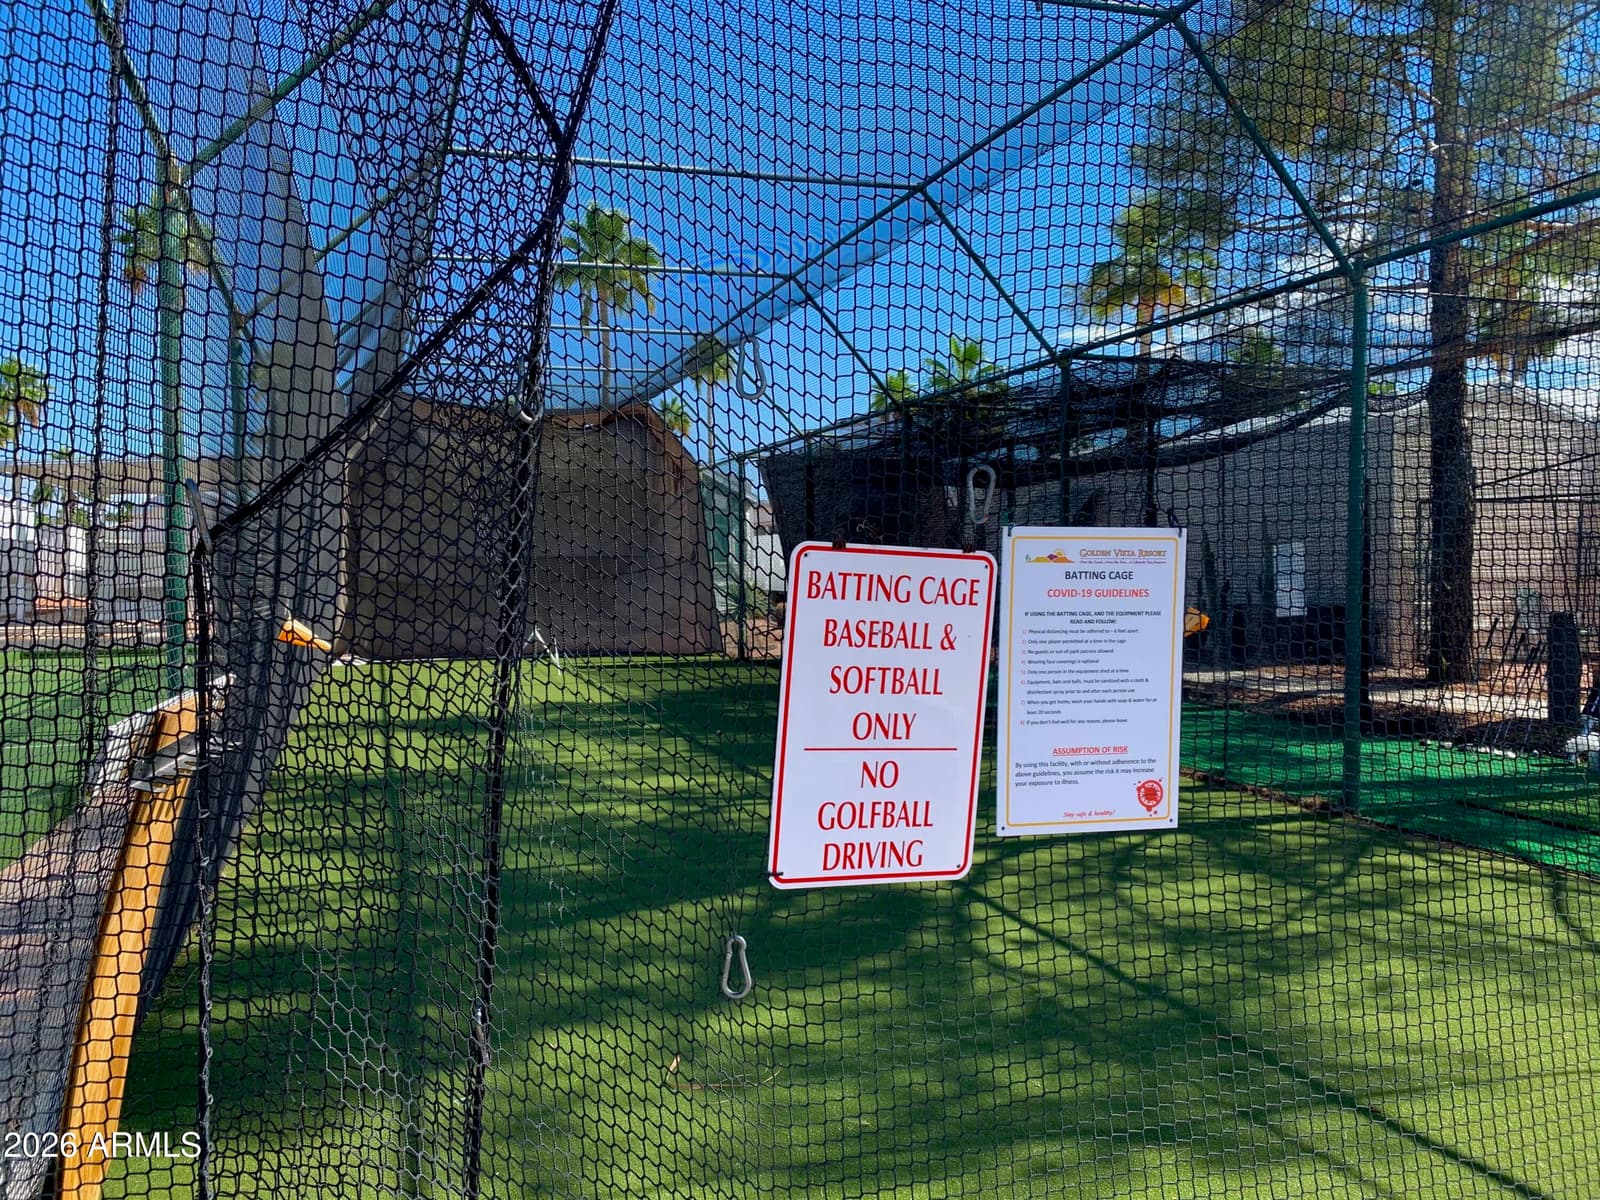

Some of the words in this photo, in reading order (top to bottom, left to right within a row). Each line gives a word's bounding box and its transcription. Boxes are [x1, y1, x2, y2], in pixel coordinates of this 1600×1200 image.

[1079, 549, 1111, 557] GOLDEN
[1114, 549, 1136, 557] VISTA
[1138, 549, 1167, 557] RESORT
[807, 570, 911, 604] BATTING
[919, 576, 980, 606] CAGE
[1064, 571, 1106, 580] BATTING
[1108, 571, 1134, 580] CAGE
[1047, 588, 1092, 598] COVID-19
[1094, 588, 1149, 598] GUIDELINES
[823, 618, 933, 650] BASEBALL
[940, 623, 957, 650] &
[829, 665, 943, 695] SOFTBALL
[852, 712, 917, 740] ONLY
[1052, 746, 1101, 756] ASSUMPTION
[1101, 746, 1112, 754] OF
[1112, 745, 1129, 754] RISK
[860, 760, 899, 788] NO
[1023, 761, 1039, 769] using
[817, 800, 933, 830] GOLFBALL
[822, 840, 923, 871] DRIVING
